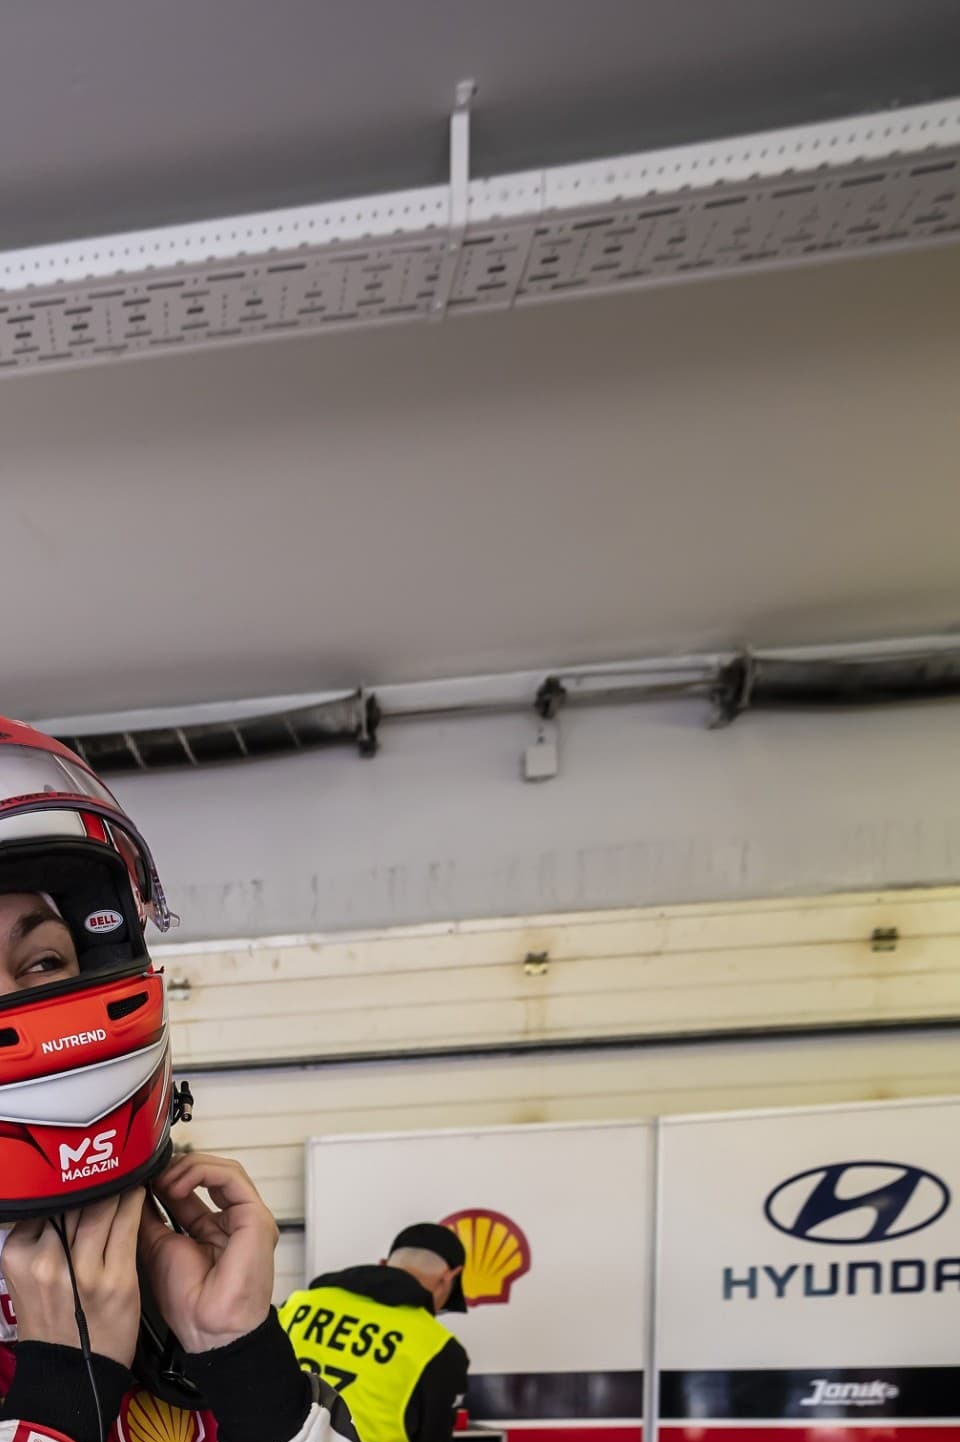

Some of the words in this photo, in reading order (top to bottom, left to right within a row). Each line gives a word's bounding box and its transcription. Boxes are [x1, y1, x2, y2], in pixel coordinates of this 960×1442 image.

[90, 914, 117, 927] BELL
[42, 1029, 106, 1054] NUTREND
[59, 1129, 117, 1170] MS
[62, 1157, 119, 1182] MAGAZIN
[723, 1256, 960, 1300] HYUNDA
[287, 1304, 404, 1364] PRESS
